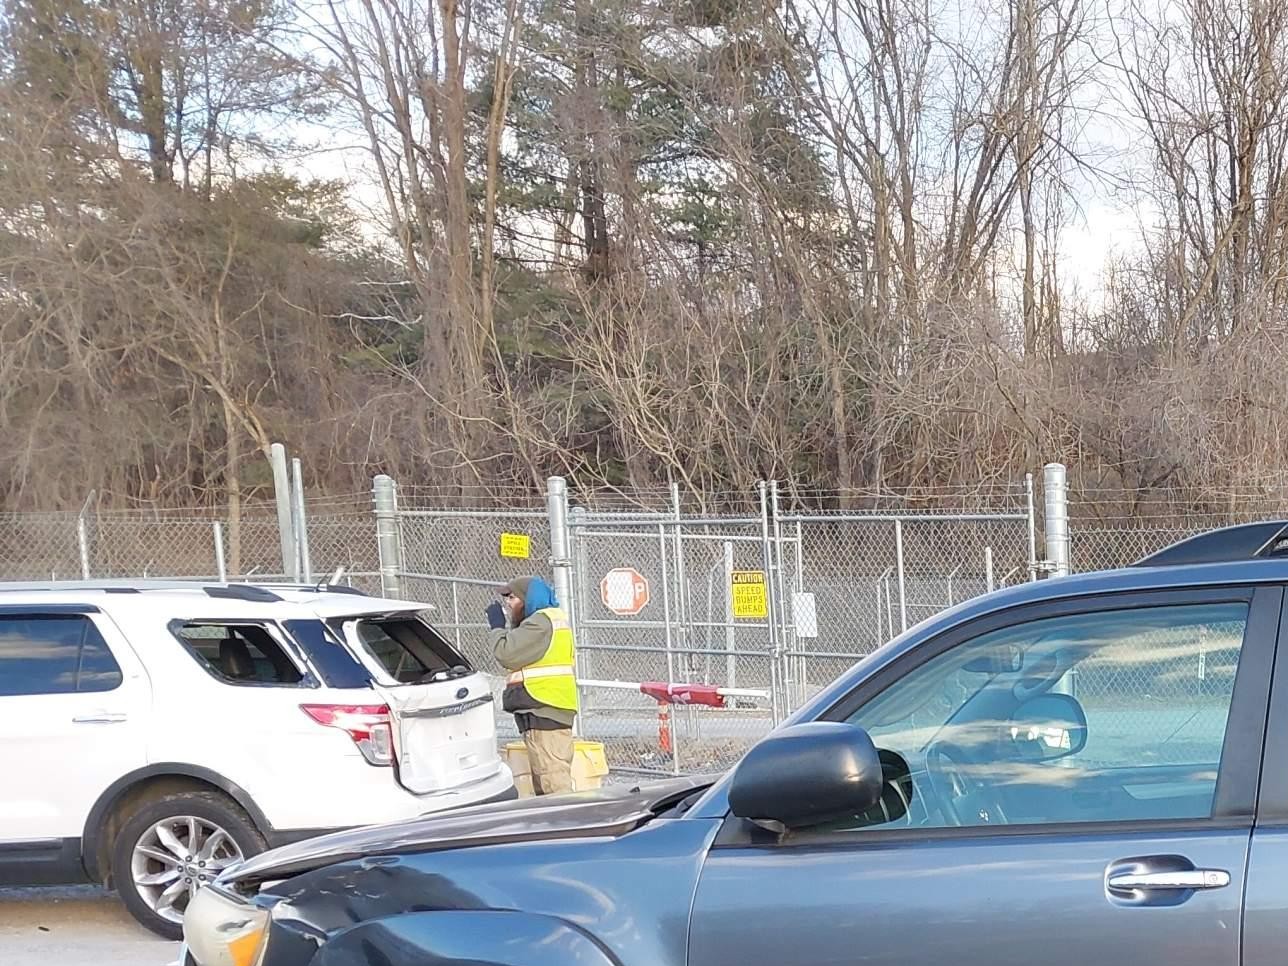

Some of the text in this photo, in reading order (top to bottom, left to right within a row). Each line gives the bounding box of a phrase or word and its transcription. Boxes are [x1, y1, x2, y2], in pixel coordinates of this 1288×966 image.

[732, 574, 763, 583] CAUTION
[736, 586, 761, 595] SPEED
[736, 595, 763, 604] BUMPS
[737, 604, 763, 613] AHEAD
